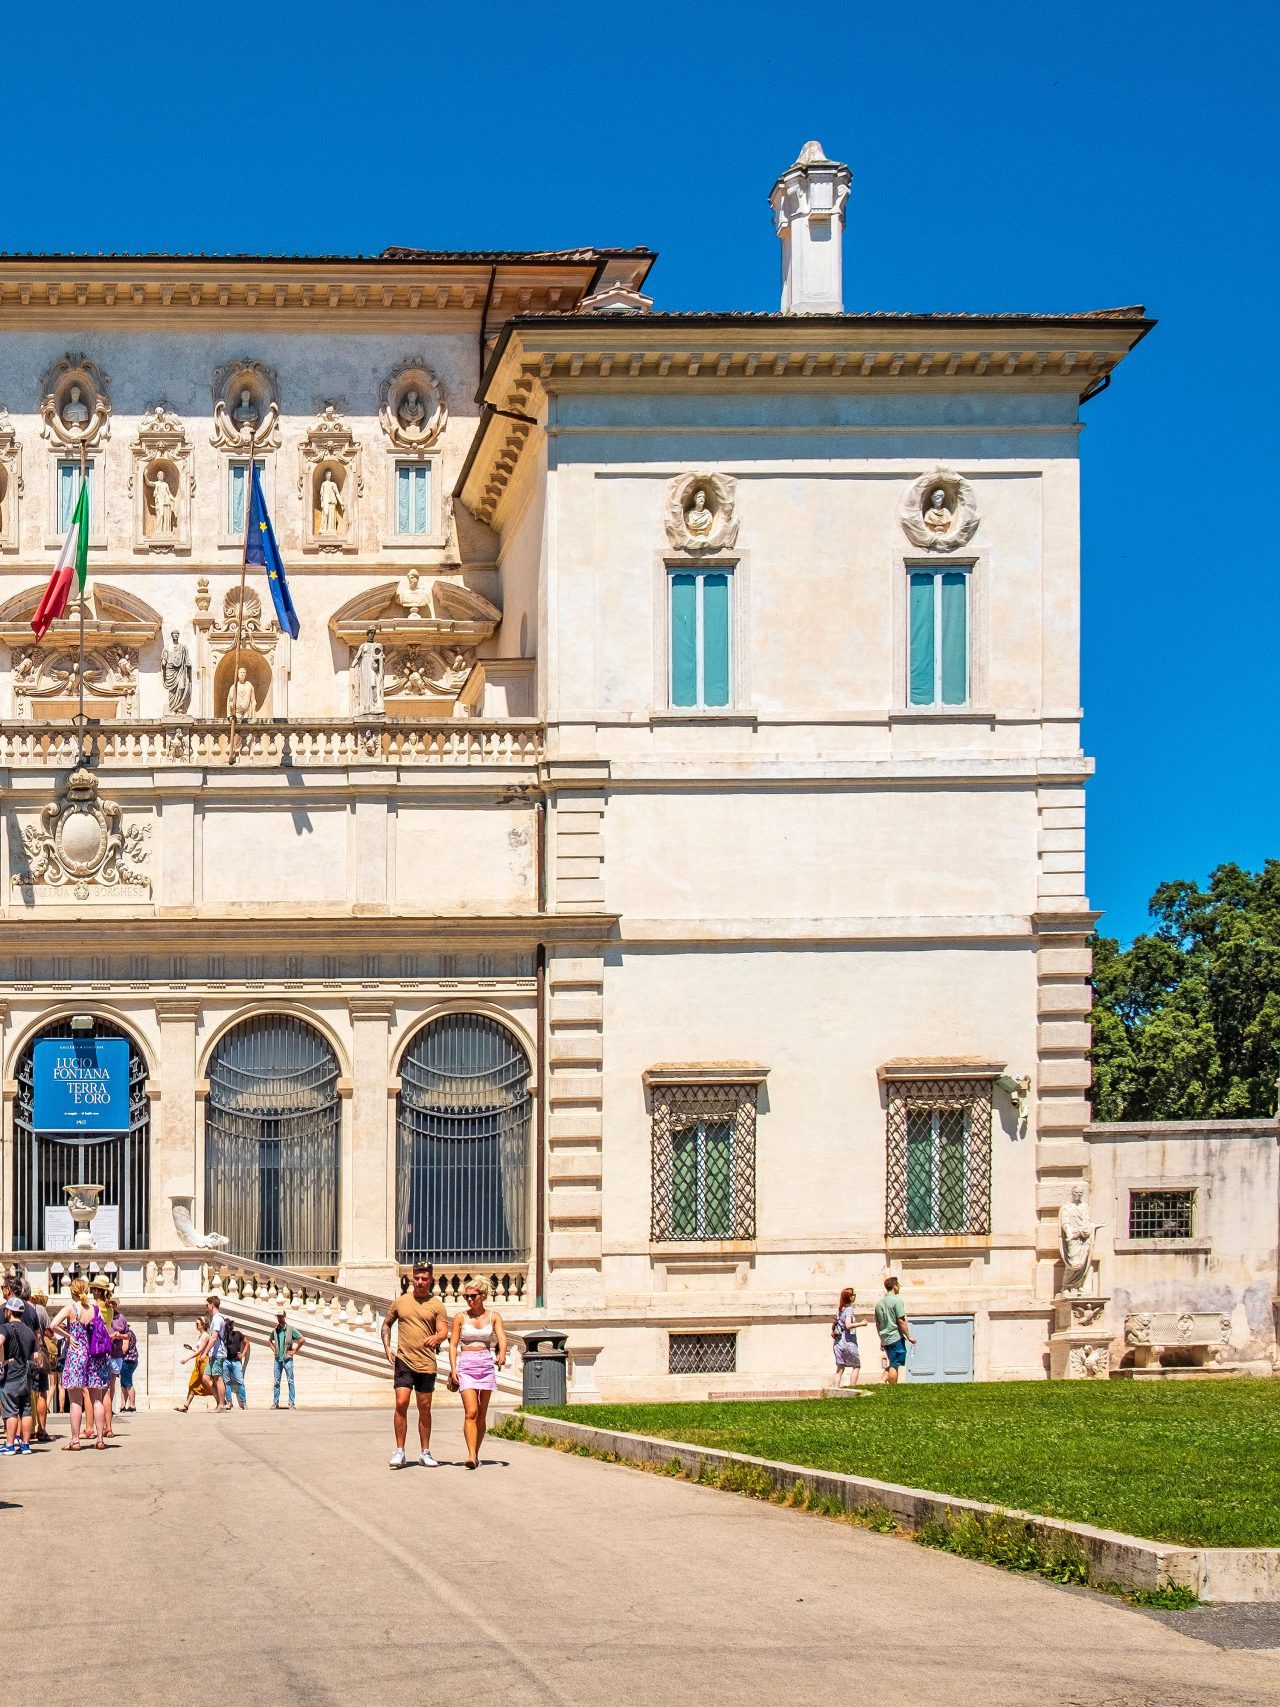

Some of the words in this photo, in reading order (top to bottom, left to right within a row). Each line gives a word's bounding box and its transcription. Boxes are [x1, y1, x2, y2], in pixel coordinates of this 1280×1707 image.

[25, 886, 70, 898] GALLERIA
[94, 886, 144, 898] BORGHESE
[56, 1057, 93, 1069] LUCIO
[53, 1068, 110, 1080] FONTANA
[66, 1082, 107, 1094] TERRA
[74, 1093, 82, 1104] E
[84, 1093, 111, 1105] ORO
